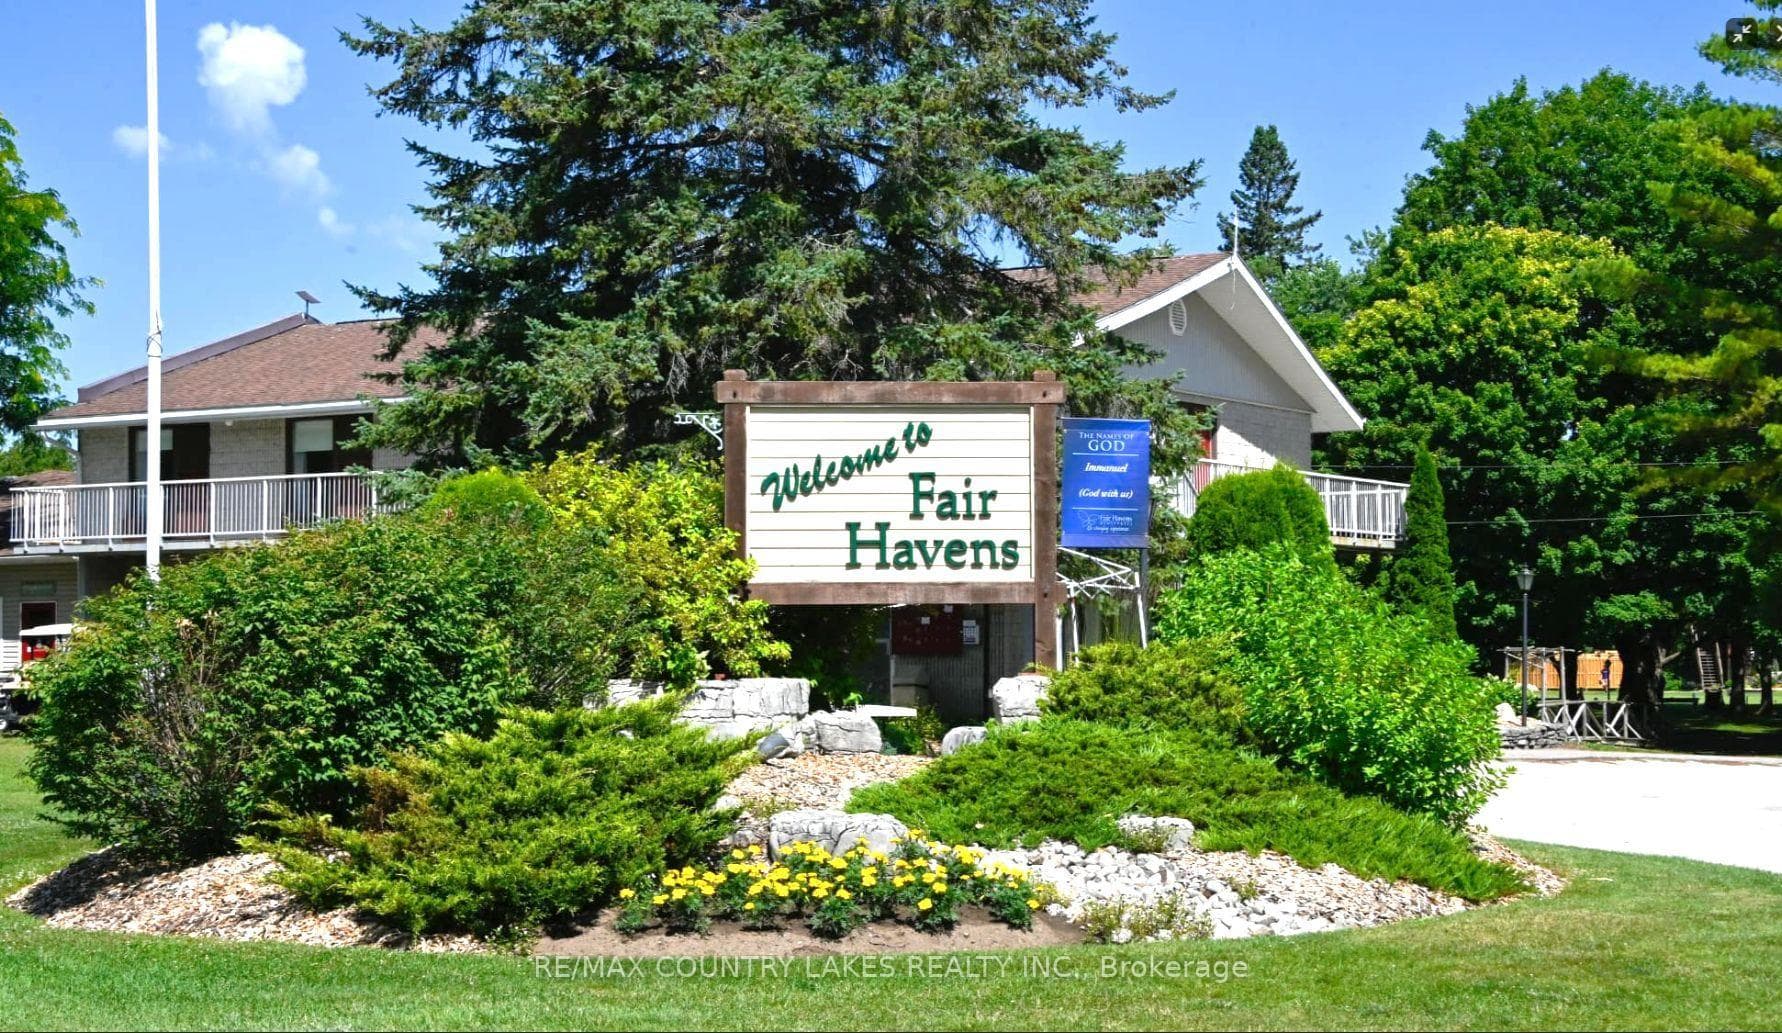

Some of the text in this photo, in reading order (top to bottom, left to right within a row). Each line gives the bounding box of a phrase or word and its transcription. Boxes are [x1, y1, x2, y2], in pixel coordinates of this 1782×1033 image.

[1088, 439, 1125, 451] GOD
[761, 421, 933, 513] Welcome to
[1084, 462, 1129, 473] Immanuel
[908, 472, 998, 520] Fair
[1079, 488, 1134, 499] (God with us)
[845, 521, 1020, 570] Havens
